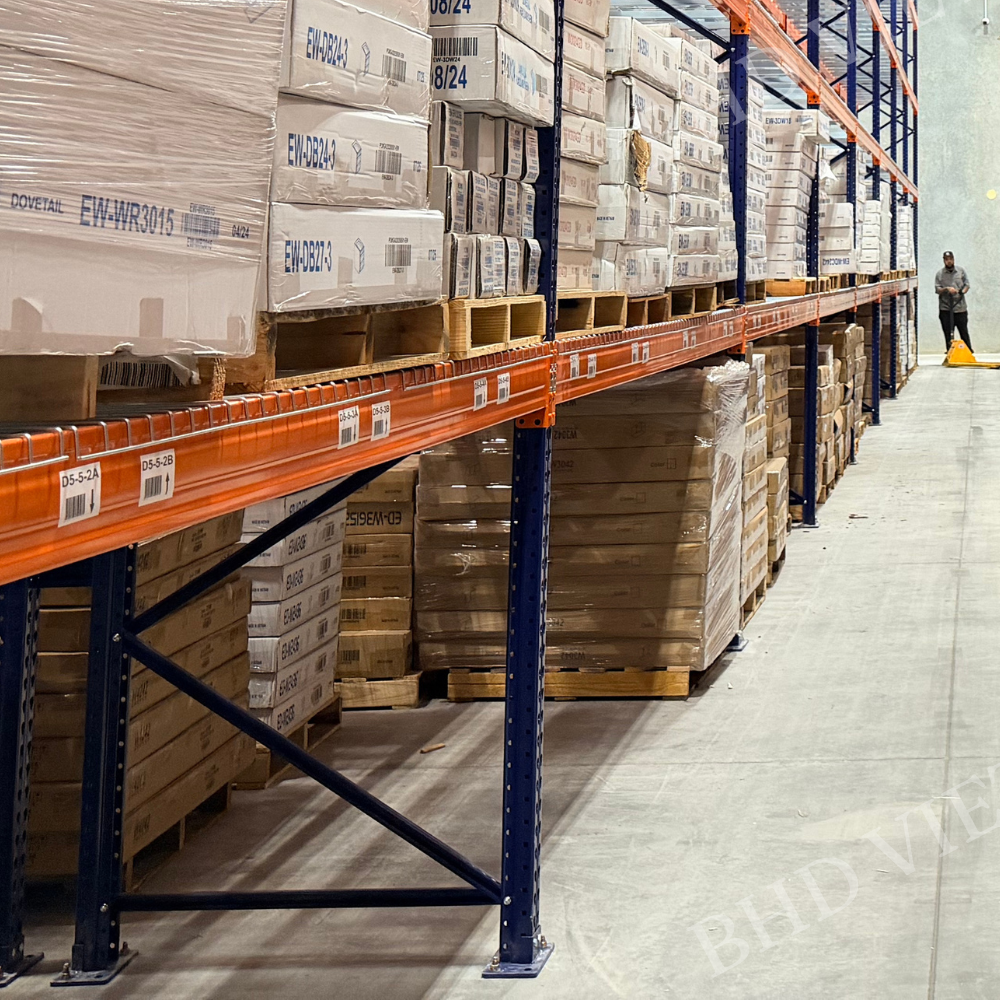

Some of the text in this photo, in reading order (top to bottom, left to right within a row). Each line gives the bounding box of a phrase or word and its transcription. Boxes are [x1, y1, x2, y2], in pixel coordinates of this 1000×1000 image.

[306, 26, 349, 69] EW-DB24-3
[432, 64, 467, 90] 8/24
[288, 133, 336, 171] EW-DB24-3
[11, 193, 64, 214] DOVETAIL
[80, 194, 175, 237] EW-WR3015
[284, 239, 332, 273] EW-DB27-3
[340, 409, 358, 422] D5-5-3A
[372, 405, 390, 416] D5-5-3B
[142, 454, 173, 472] D5-5-2B
[62, 468, 99, 487] D5-5-2A
